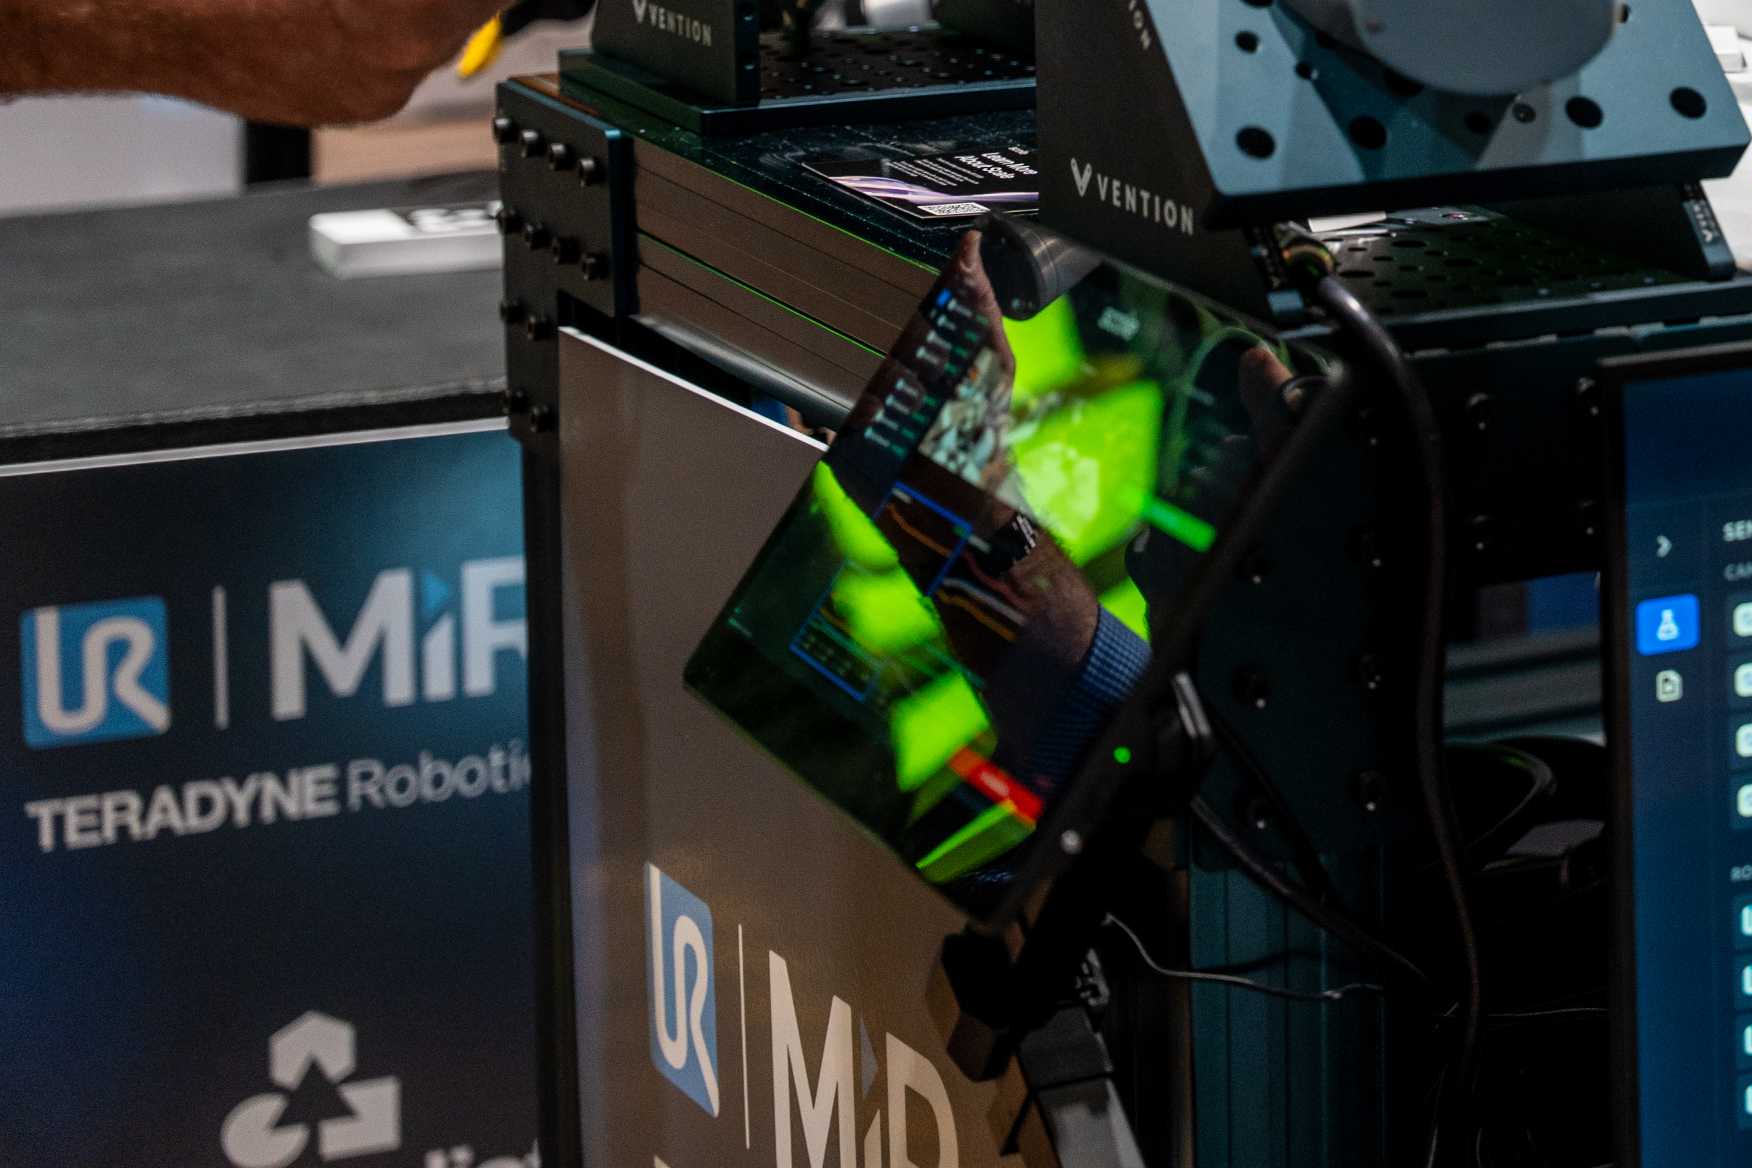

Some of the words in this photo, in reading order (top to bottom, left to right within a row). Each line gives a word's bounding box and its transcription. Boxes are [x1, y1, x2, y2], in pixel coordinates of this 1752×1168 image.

[648, 4, 712, 47] VENTION
[1096, 172, 1195, 235] VENTION
[35, 606, 172, 735] UR
[24, 763, 342, 853] TERADYNE
[648, 862, 721, 1119] UR
